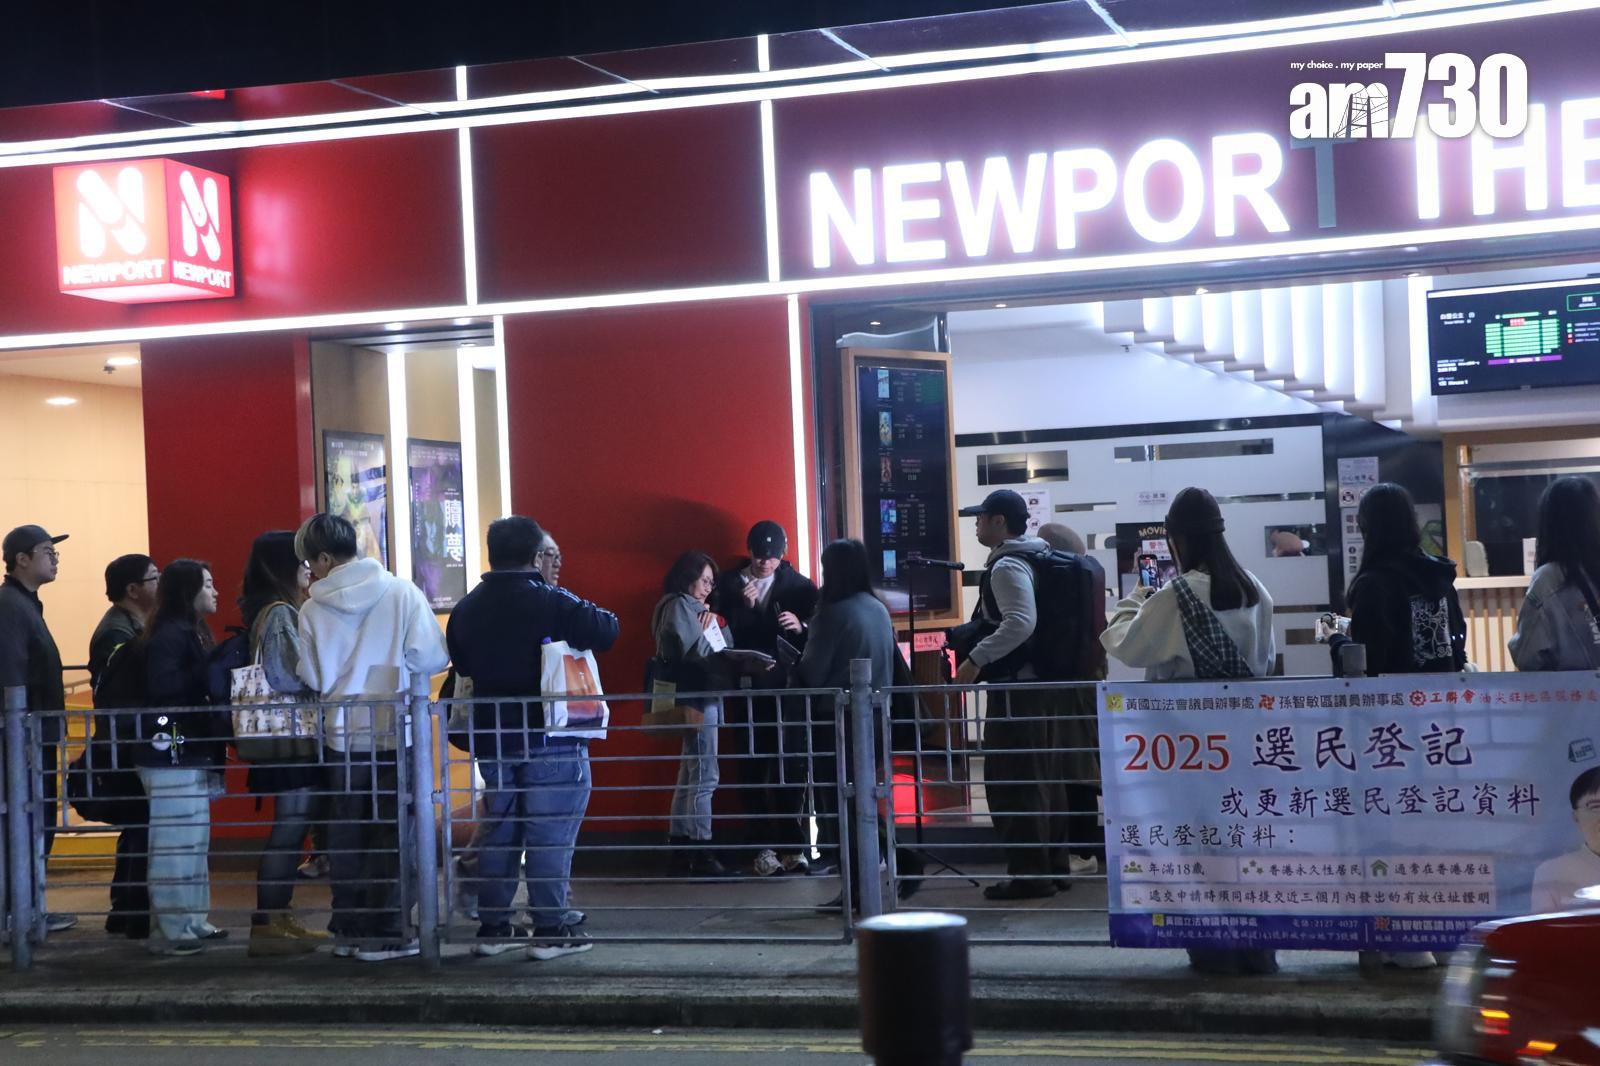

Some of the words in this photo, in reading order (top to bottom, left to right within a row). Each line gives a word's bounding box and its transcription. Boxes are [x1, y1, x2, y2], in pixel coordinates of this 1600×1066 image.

[808, 130, 1357, 269] NEWPORT
[61, 258, 166, 285] NEWPORT
[172, 260, 232, 289] NEWPORT
[1124, 734, 1230, 771] 2025
[1252, 722, 1472, 772] 選民登記
[1220, 783, 1541, 819] 或更新選民登記資料
[1269, 862, 1362, 876] 香港永久性居民
[1394, 862, 1491, 876] 通常在香港居住
